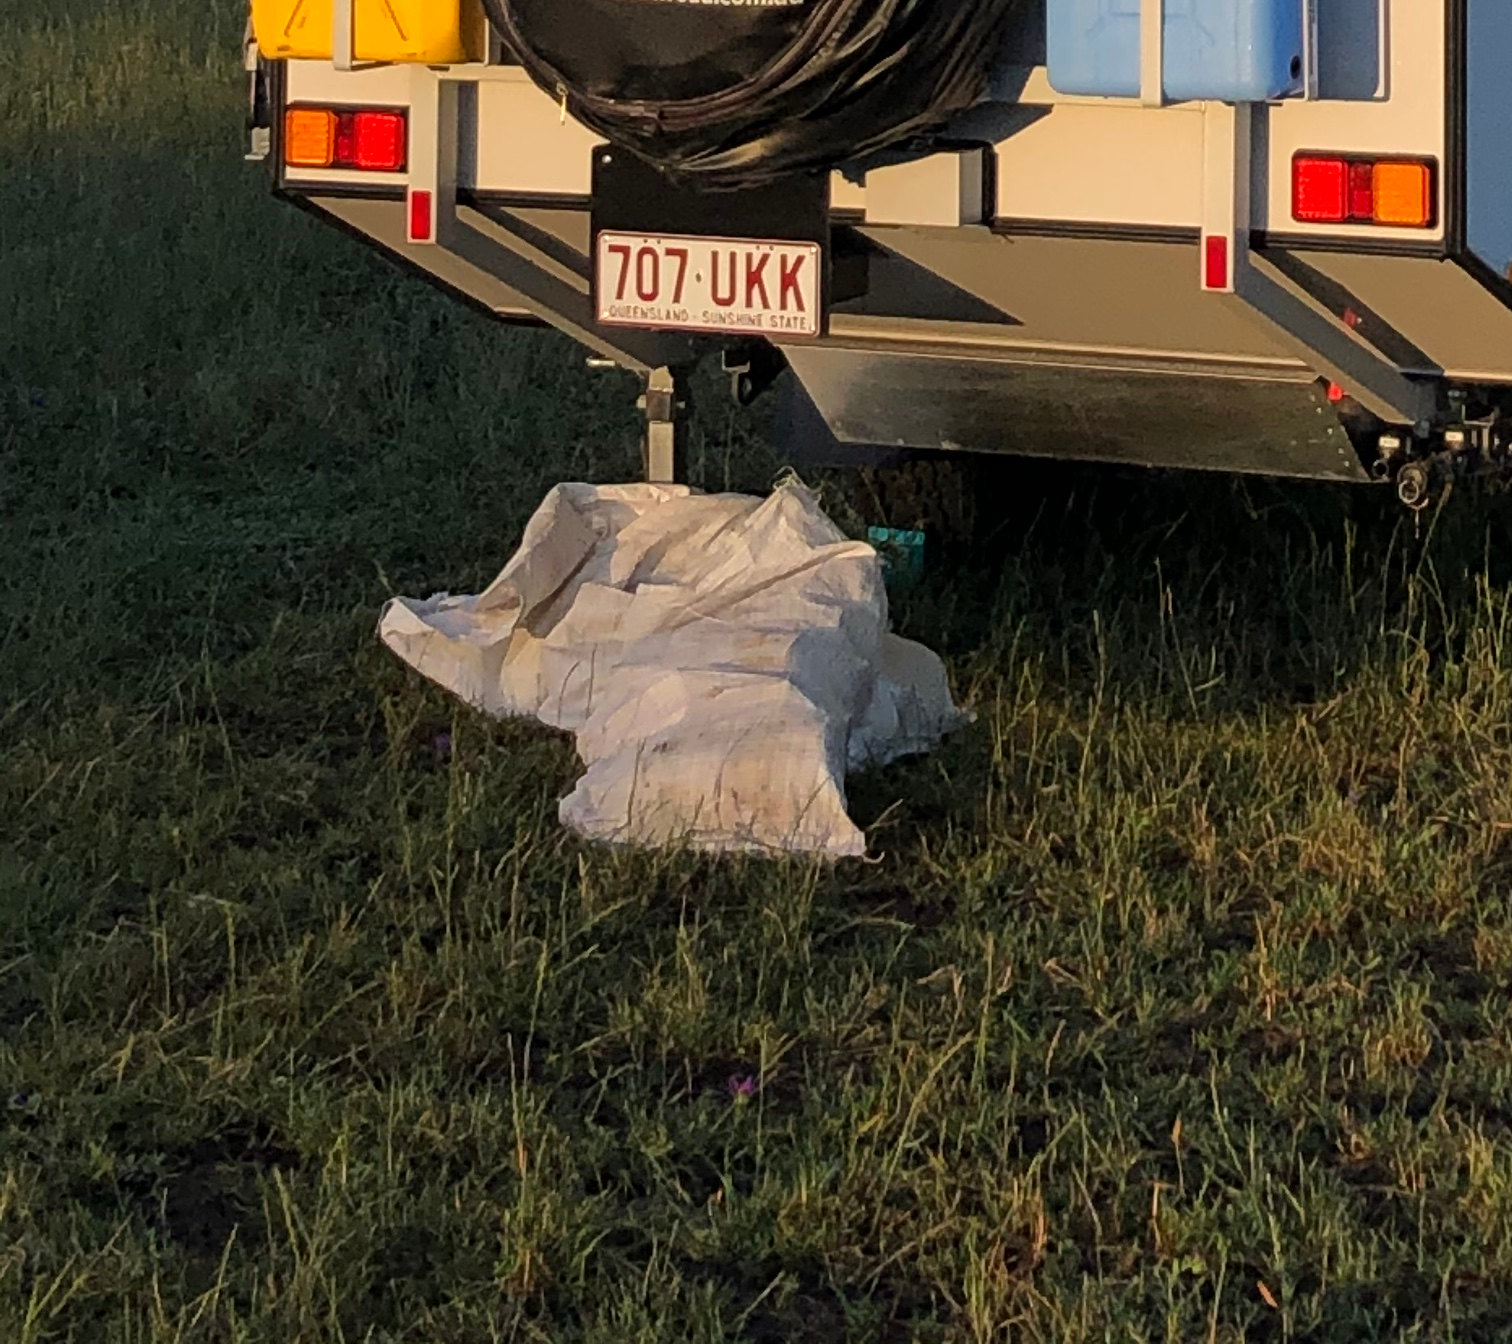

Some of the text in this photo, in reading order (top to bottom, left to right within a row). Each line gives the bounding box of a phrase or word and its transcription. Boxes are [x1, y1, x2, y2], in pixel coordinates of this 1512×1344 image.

[607, 304, 807, 330] QUEENSLAND SUNSHINE STATE
